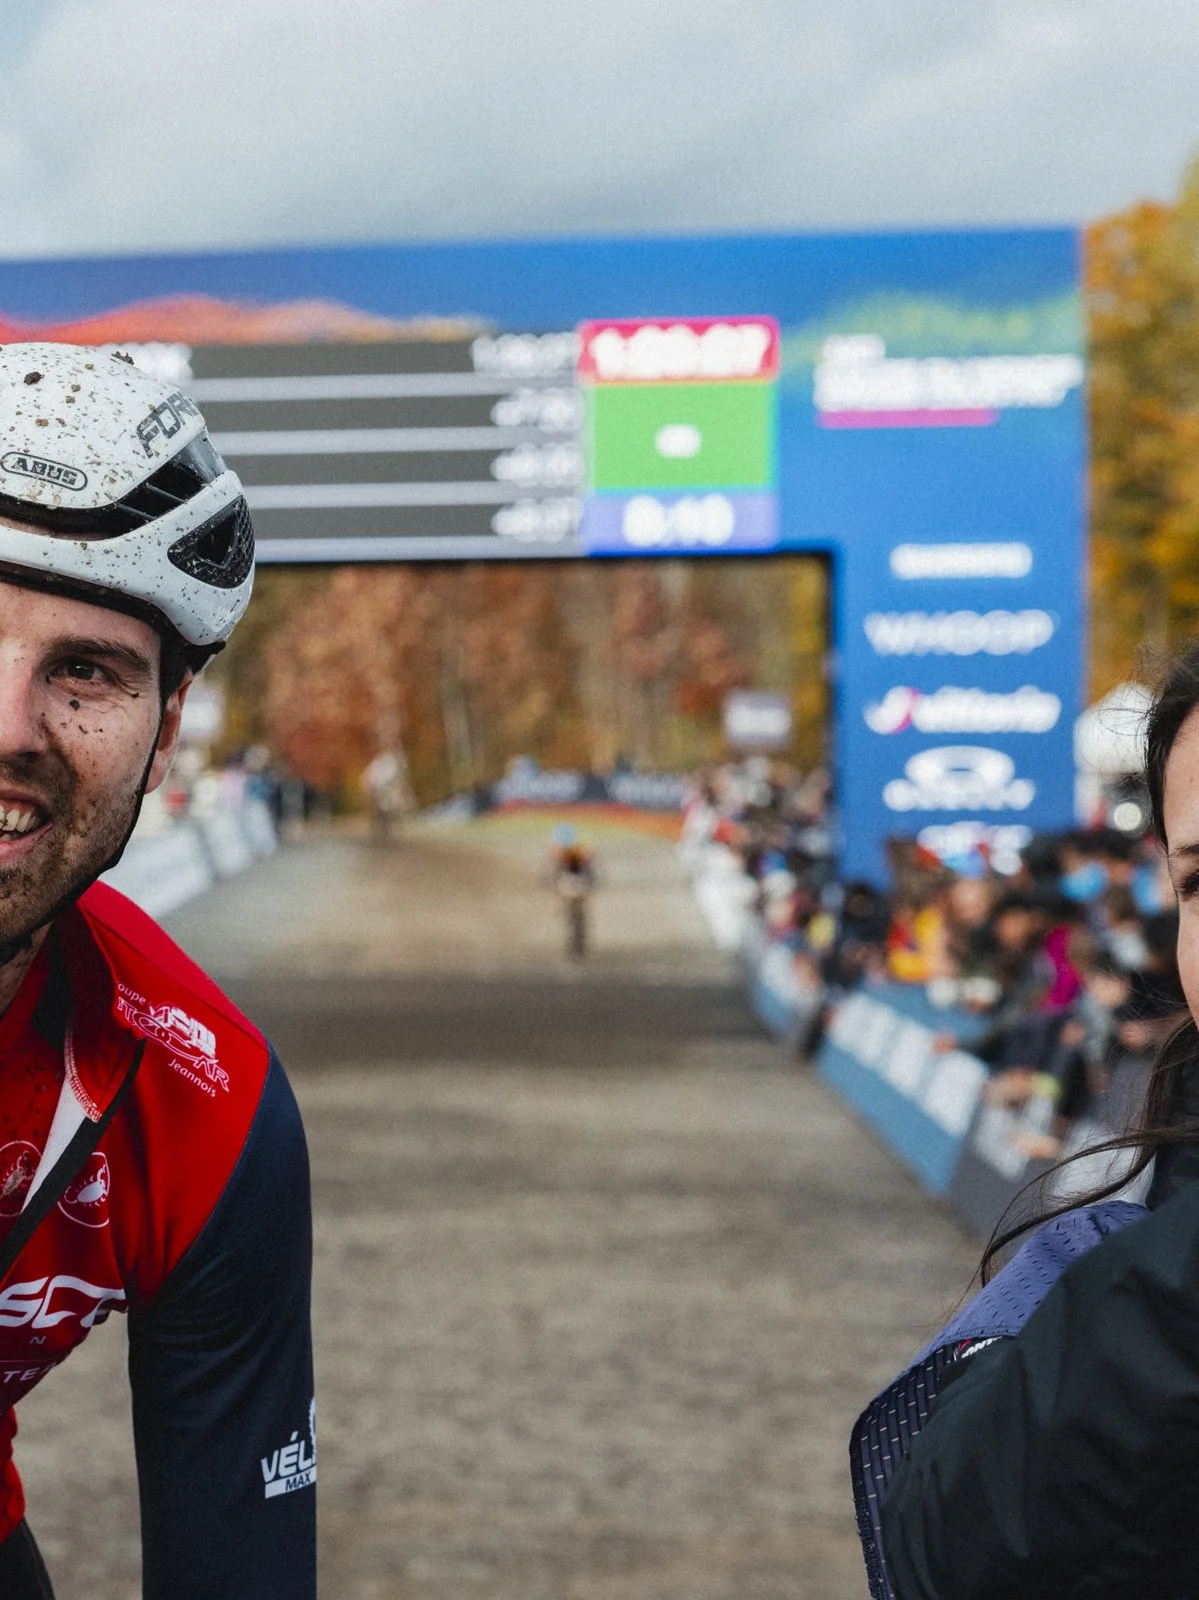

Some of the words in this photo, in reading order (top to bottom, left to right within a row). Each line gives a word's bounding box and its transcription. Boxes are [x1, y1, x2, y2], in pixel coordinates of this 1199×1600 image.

[11, 457, 77, 485] ABUS
[117, 982, 146, 1004] oupe
[168, 1058, 217, 1097] Jeannois
[261, 1431, 316, 1483] VÉL
[285, 1472, 311, 1491] MAX
